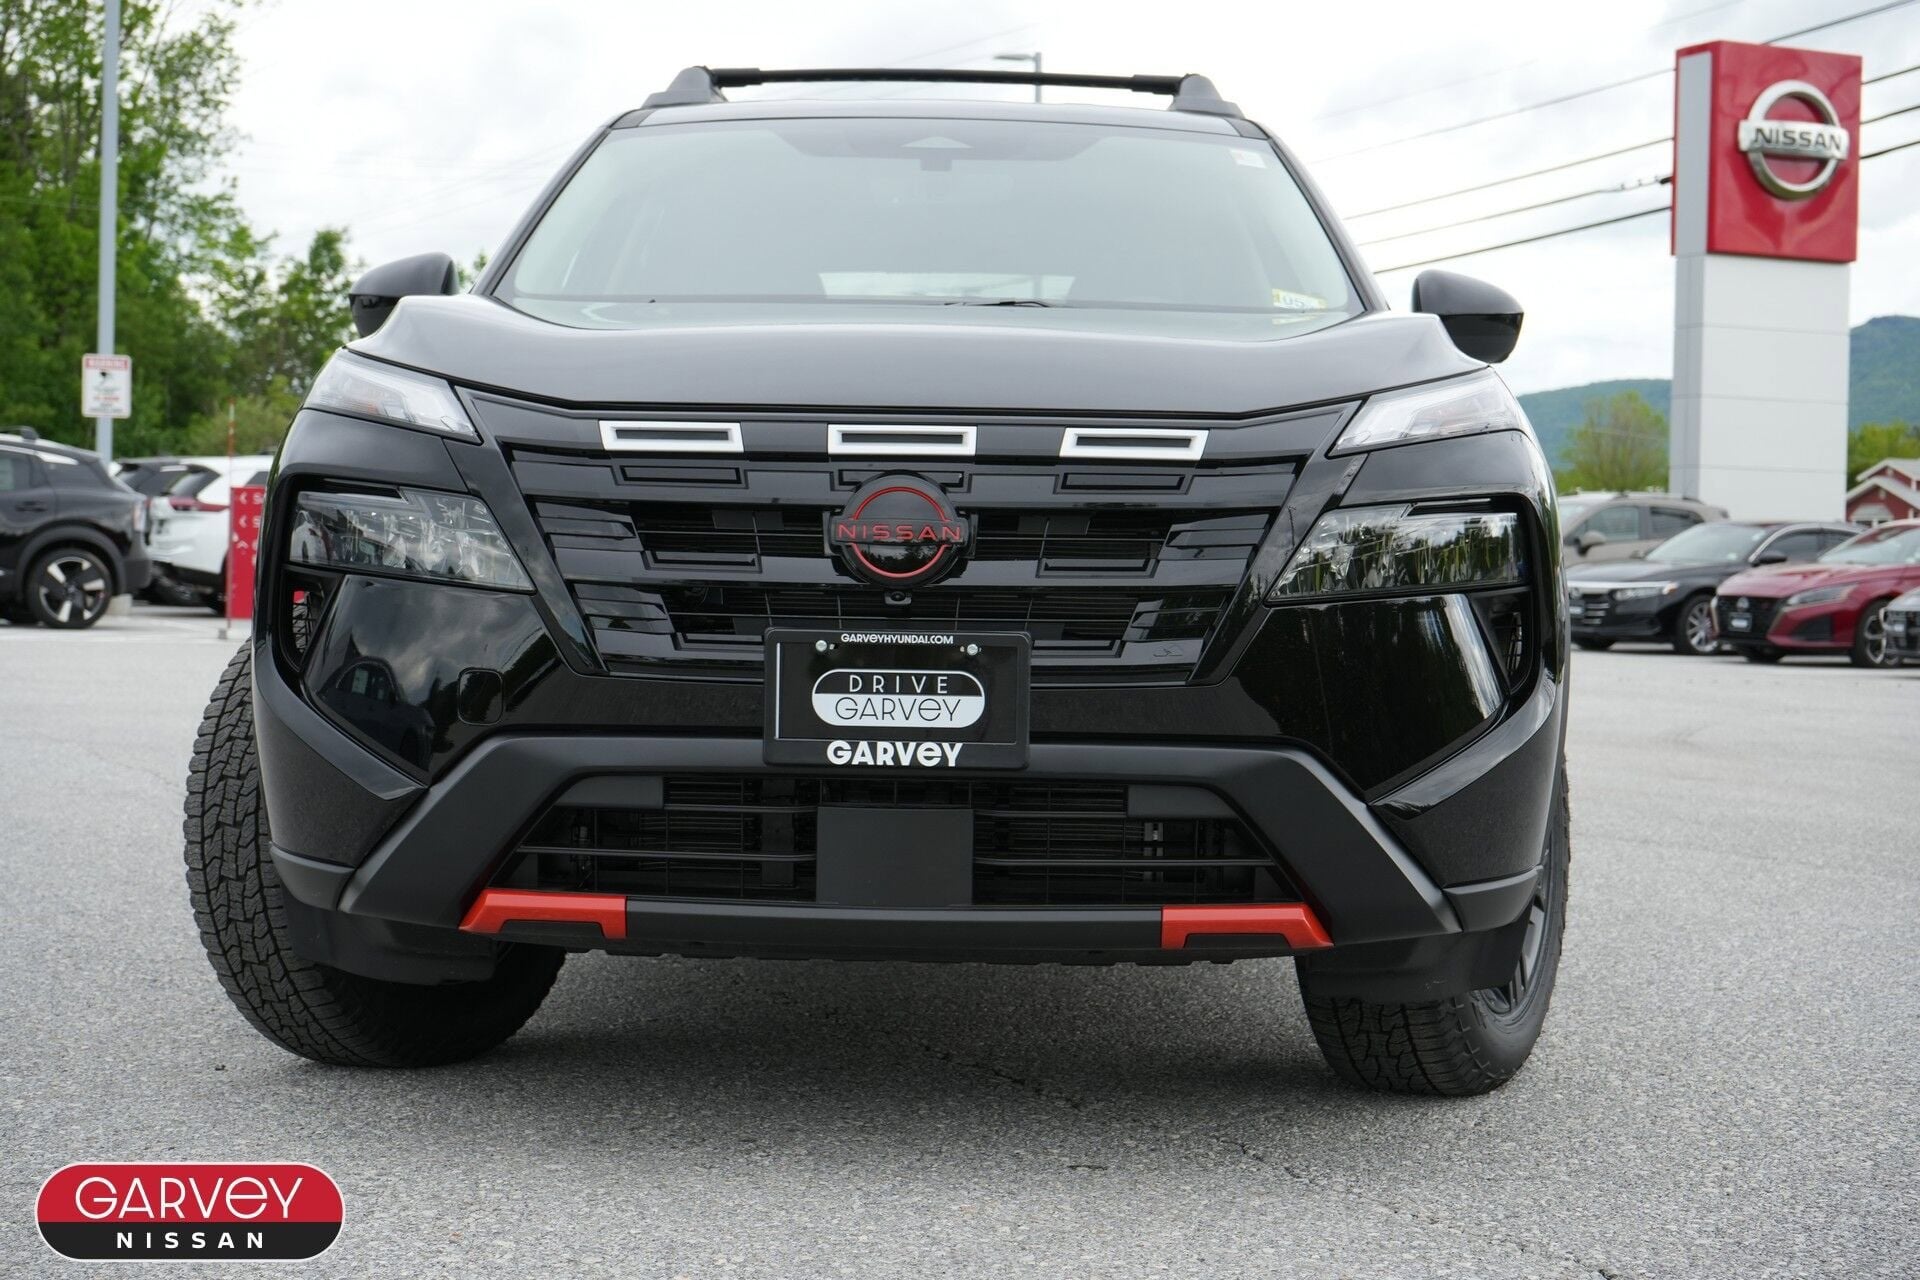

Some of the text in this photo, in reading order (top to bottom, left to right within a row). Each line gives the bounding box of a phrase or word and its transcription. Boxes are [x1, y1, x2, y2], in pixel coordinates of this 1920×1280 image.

[1753, 127, 1842, 151] NISSAN
[838, 523, 961, 541] NISSAN
[849, 675, 949, 694] DRIVE
